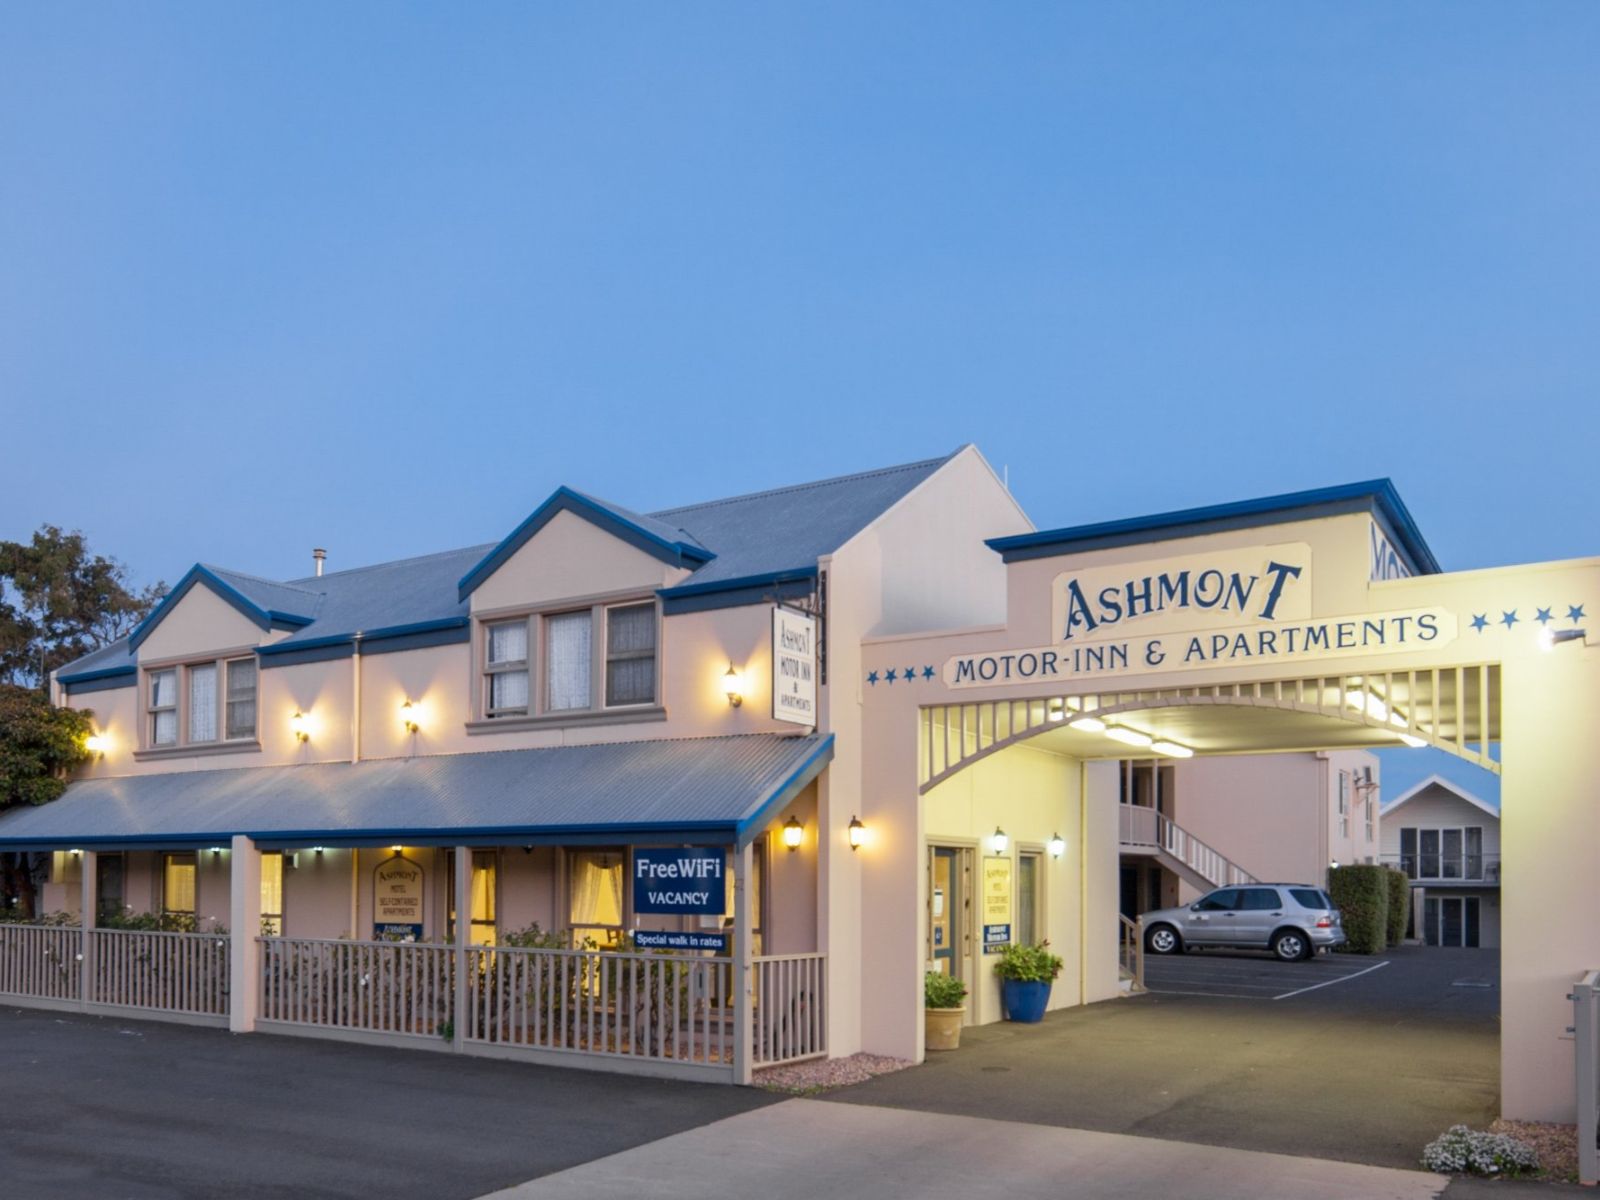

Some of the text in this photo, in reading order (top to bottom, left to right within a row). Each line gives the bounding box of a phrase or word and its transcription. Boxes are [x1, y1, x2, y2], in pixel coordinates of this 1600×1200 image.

[1064, 561, 1302, 640] ASHMONT
[780, 619, 811, 655] ASHMONT
[955, 614, 1439, 683] MOTOR-INN & APARTMENTS
[780, 656, 811, 681] MOTOR INN
[780, 693, 811, 712] APARTMENTS
[637, 858, 721, 878] FreeWiFi
[648, 892, 709, 905] VACANCY
[636, 934, 722, 948] Special walk in rates
